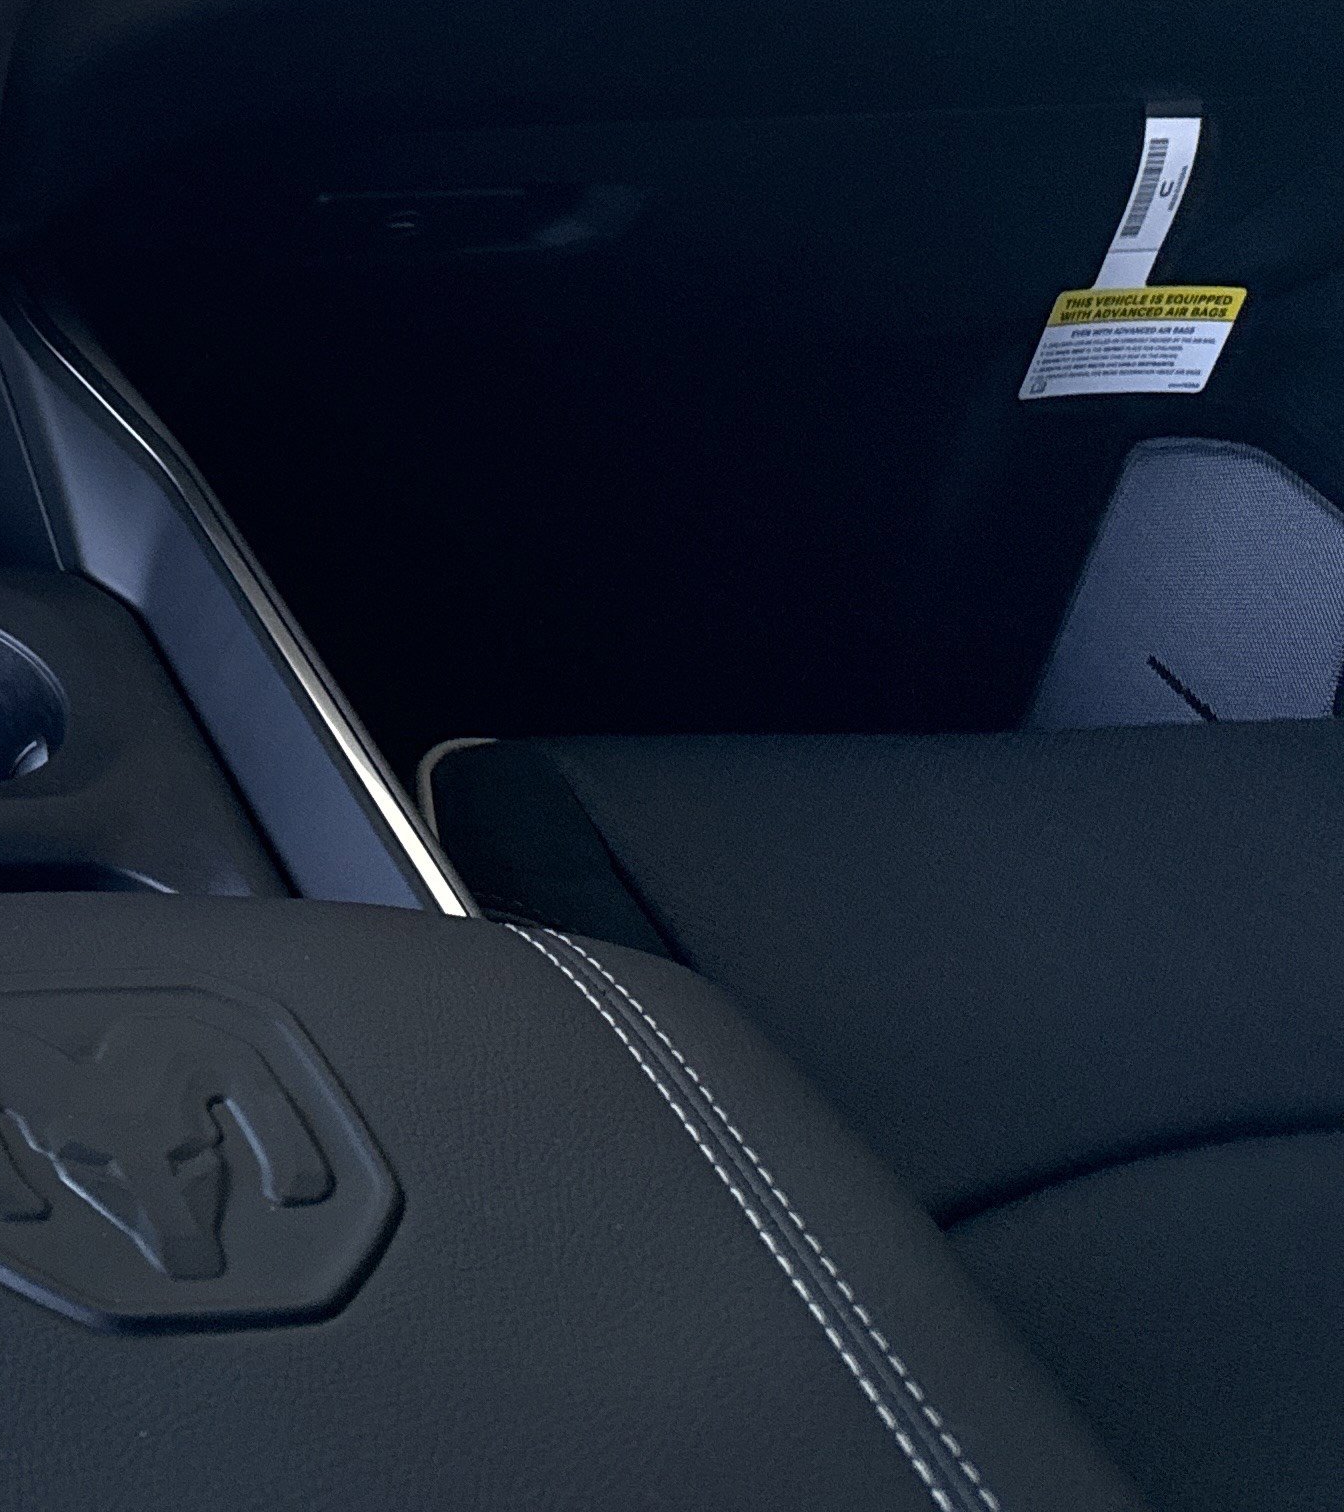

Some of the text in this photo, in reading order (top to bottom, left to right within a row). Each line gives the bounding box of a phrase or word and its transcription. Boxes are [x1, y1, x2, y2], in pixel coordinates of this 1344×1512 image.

[1065, 294, 1234, 310] THIS VEHICLE IS EQUIPPED
[1060, 307, 1228, 321] WITH ADVANCED AIR BAGS
